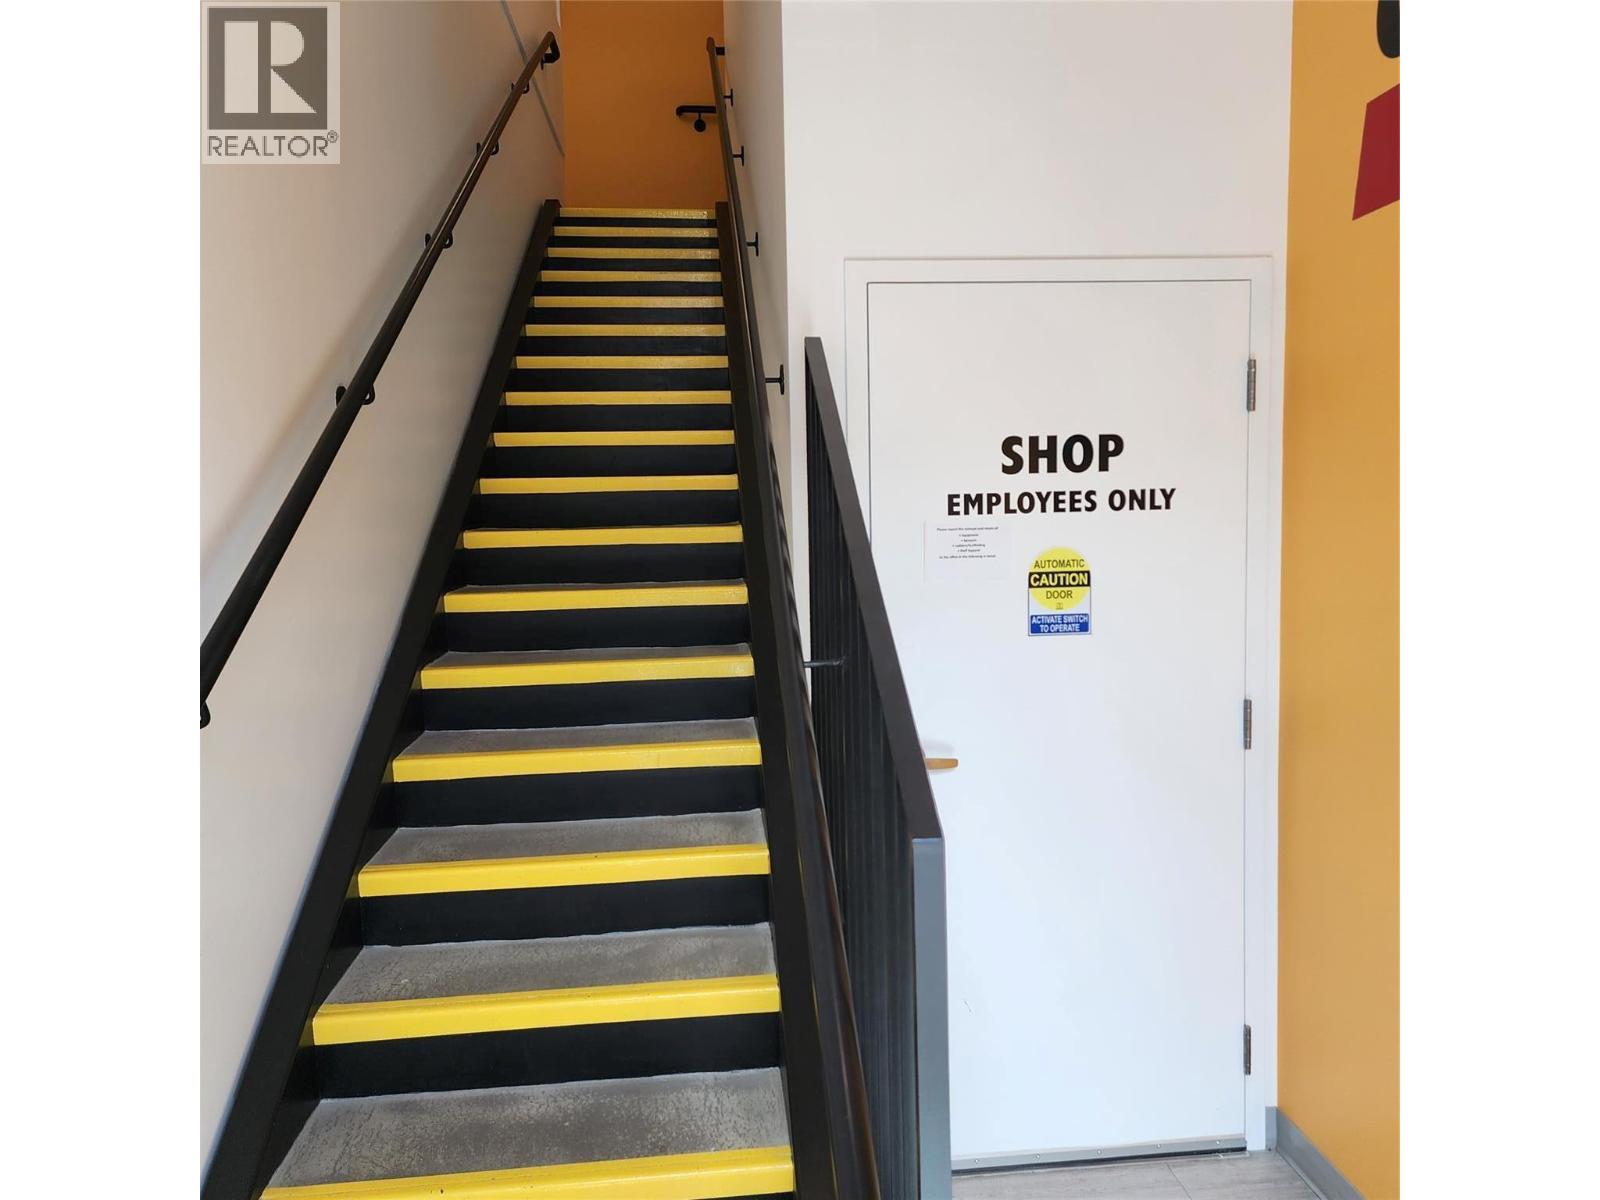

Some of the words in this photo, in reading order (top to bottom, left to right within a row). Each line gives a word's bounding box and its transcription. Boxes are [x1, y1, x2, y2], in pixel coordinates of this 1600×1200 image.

[1001, 434, 1124, 475] SHOP
[947, 490, 1097, 516] EMPLOYEES
[1108, 488, 1176, 511] ONLY
[1034, 559, 1085, 568] AUTOMATIC
[1030, 573, 1088, 586] CAUTION
[1046, 590, 1073, 599] DOOR
[1032, 616, 1062, 624] ACTIVATE
[1063, 615, 1088, 623] SWITCH
[1050, 624, 1080, 632] OPERATE
